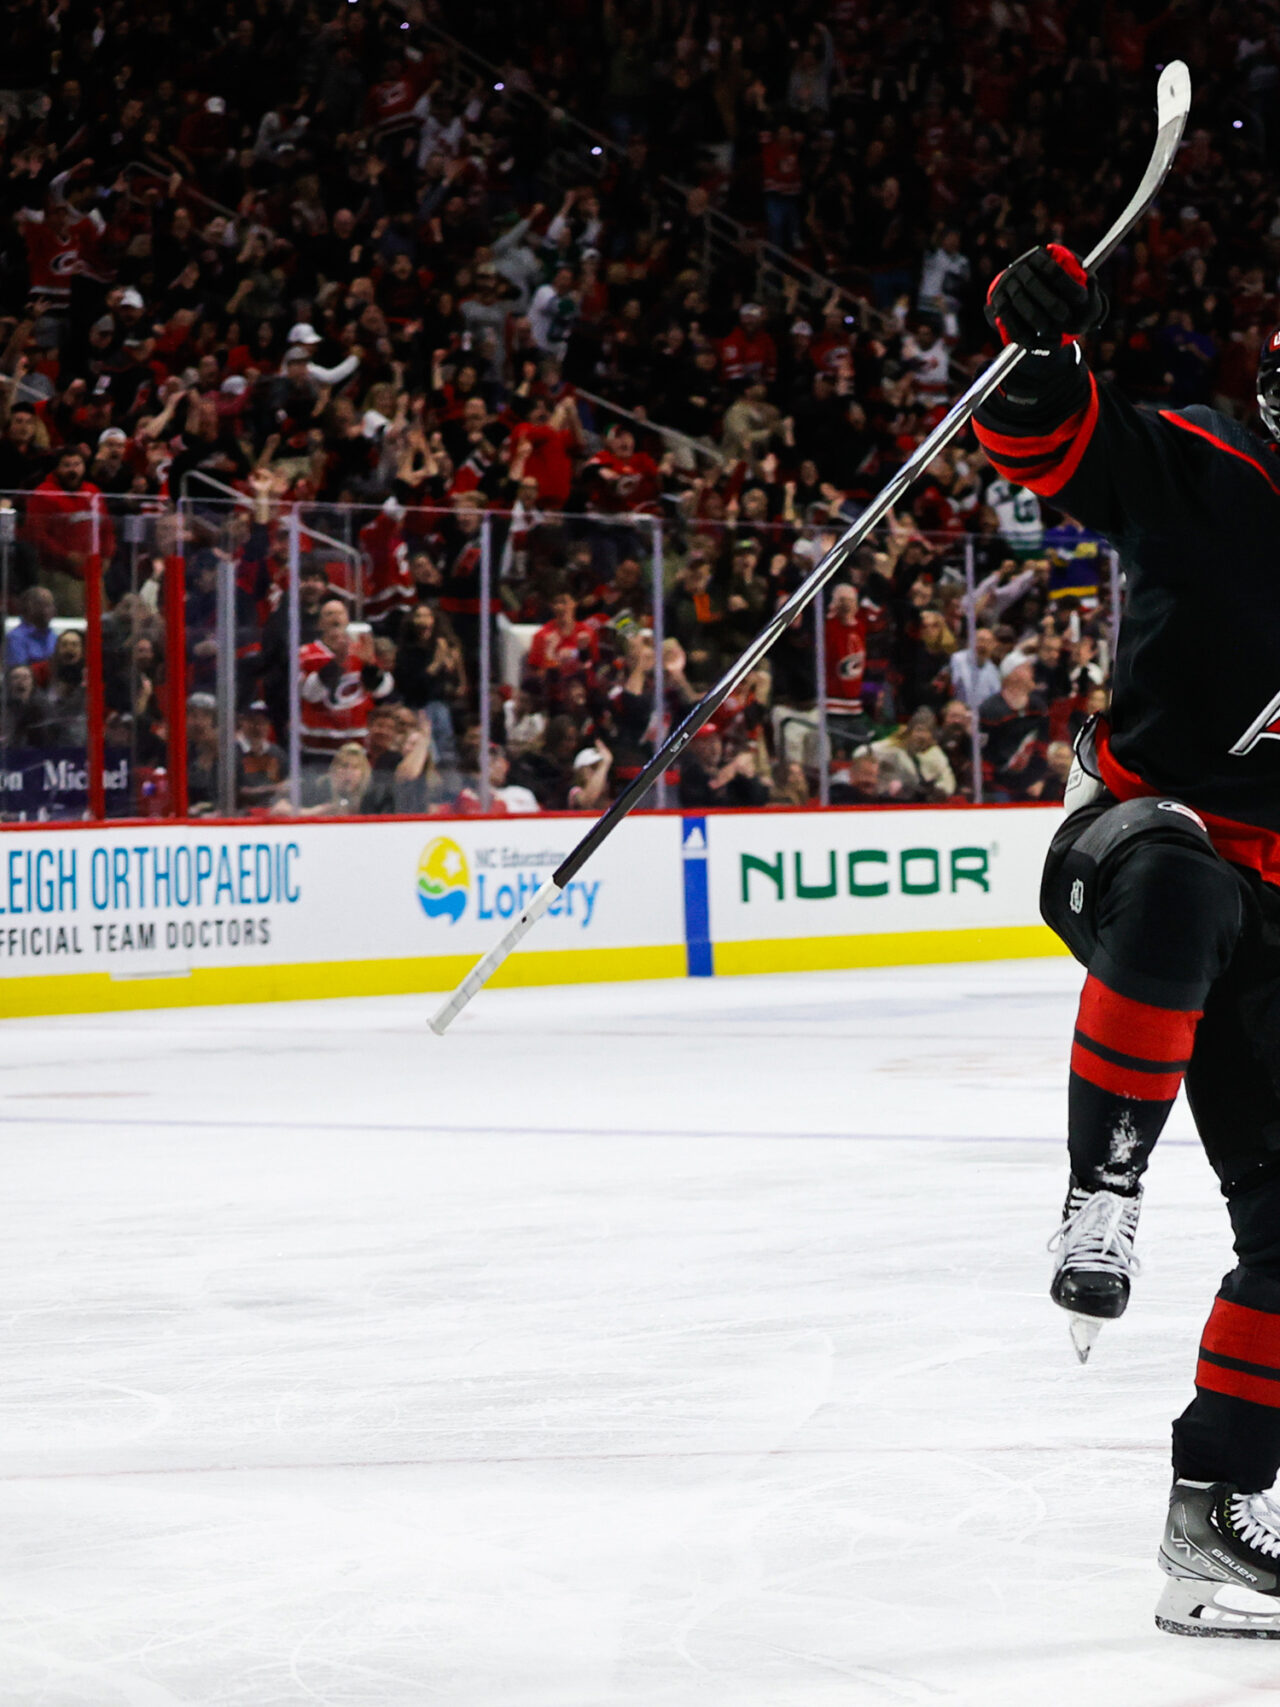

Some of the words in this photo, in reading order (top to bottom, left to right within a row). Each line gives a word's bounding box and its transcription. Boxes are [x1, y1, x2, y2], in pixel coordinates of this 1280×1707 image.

[43, 758, 128, 791] Micel
[0, 849, 76, 914] EIGH
[91, 842, 301, 910] ORTHOPAEDIC
[740, 847, 990, 902] NUCOR
[93, 921, 155, 952] TEAM
[166, 916, 271, 949] DOCTORS
